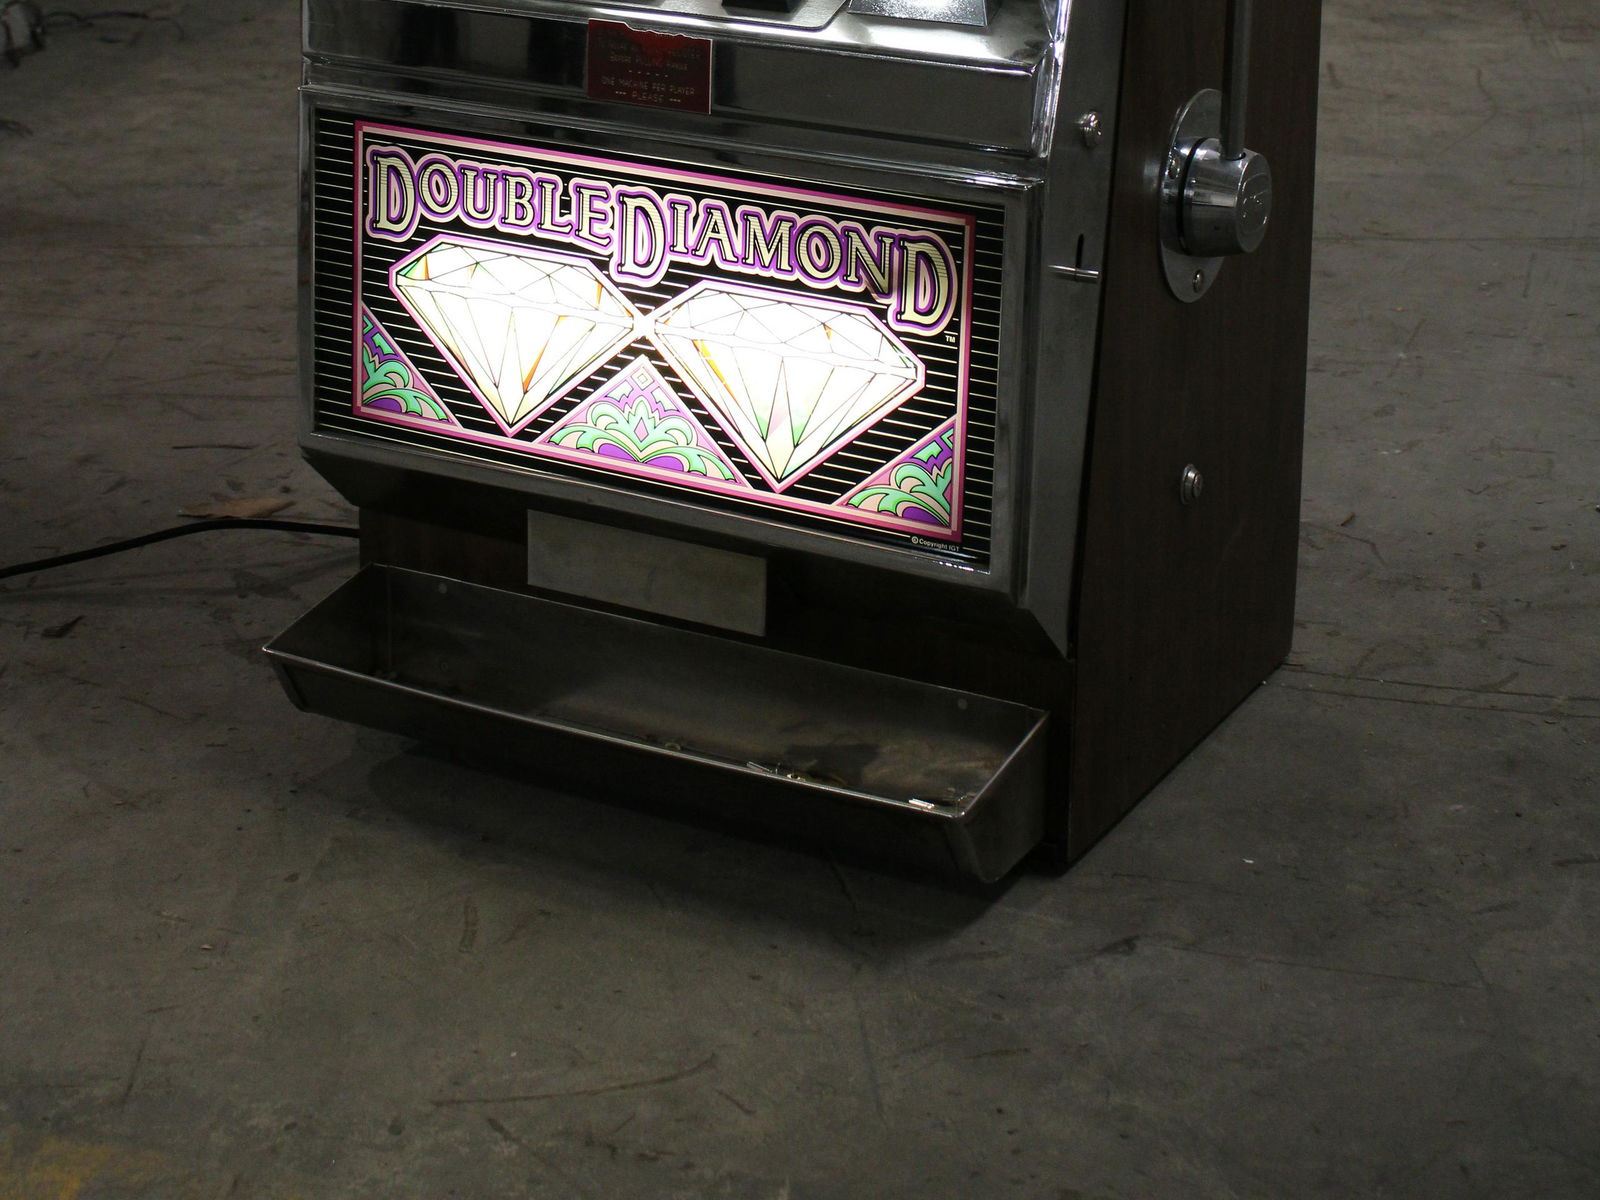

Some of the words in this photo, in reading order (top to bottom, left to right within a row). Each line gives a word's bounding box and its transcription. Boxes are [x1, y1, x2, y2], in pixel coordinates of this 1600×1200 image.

[369, 147, 613, 249] DOUBLE
[616, 190, 953, 332] DIAMOND
[945, 334, 956, 344] TM
[948, 543, 960, 552] IGT
